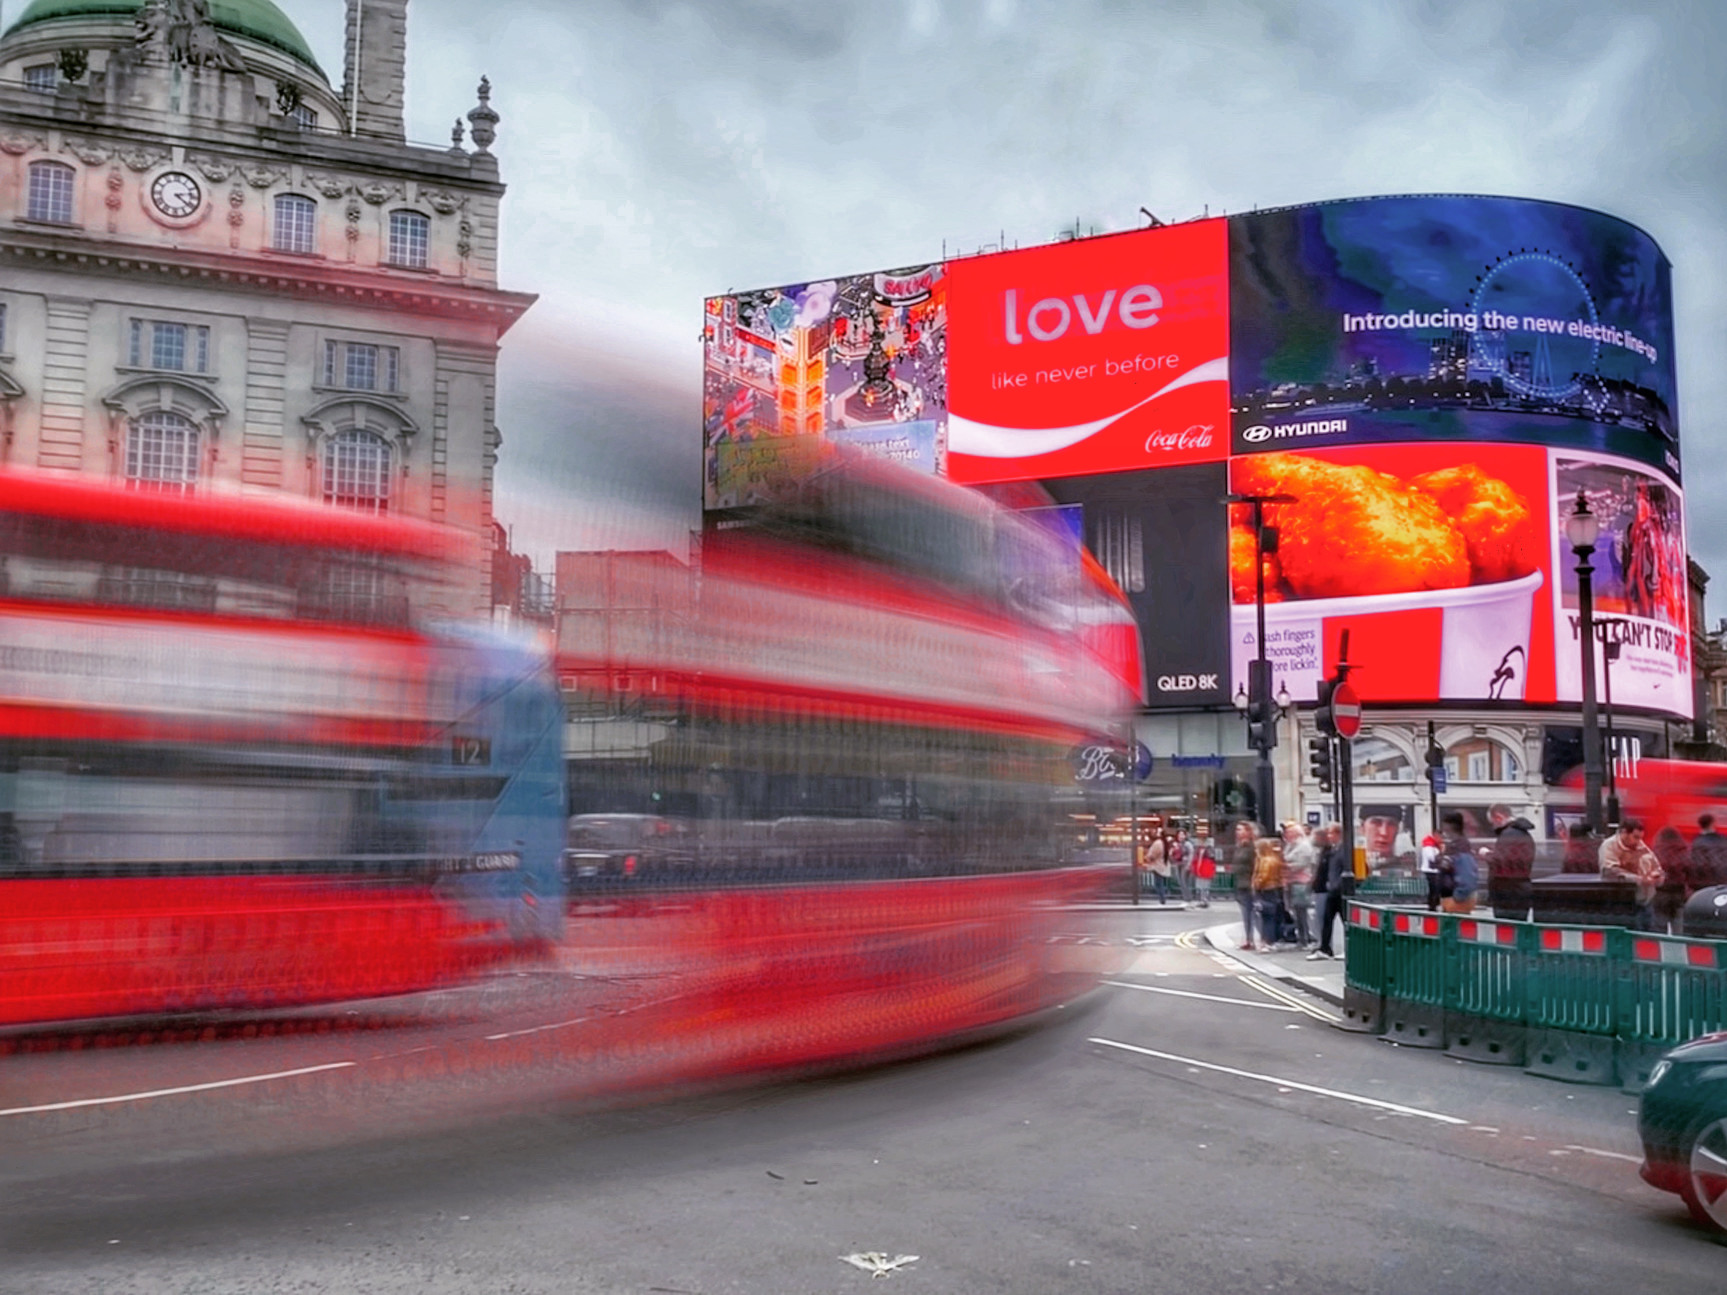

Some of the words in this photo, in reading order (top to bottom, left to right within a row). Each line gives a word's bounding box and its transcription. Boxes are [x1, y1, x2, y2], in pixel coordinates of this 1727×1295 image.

[1004, 284, 1163, 345] love
[1343, 308, 1478, 332] Introducing
[1483, 309, 1519, 330] the
[1523, 316, 1564, 334] new
[1567, 318, 1624, 347] electric
[1624, 329, 1658, 364] line-up
[991, 371, 1028, 390] like
[1035, 364, 1097, 384] never
[1105, 353, 1180, 376] before
[1274, 419, 1347, 438] HYUNDAI
[1283, 628, 1316, 643] fingers
[1611, 617, 1652, 649] CAN'T
[1655, 626, 1672, 654] STOP
[1265, 642, 1317, 658] thoroughly
[1157, 674, 1197, 692] QLED
[1198, 674, 1219, 690] 8K
[459, 740, 482, 764] 12
